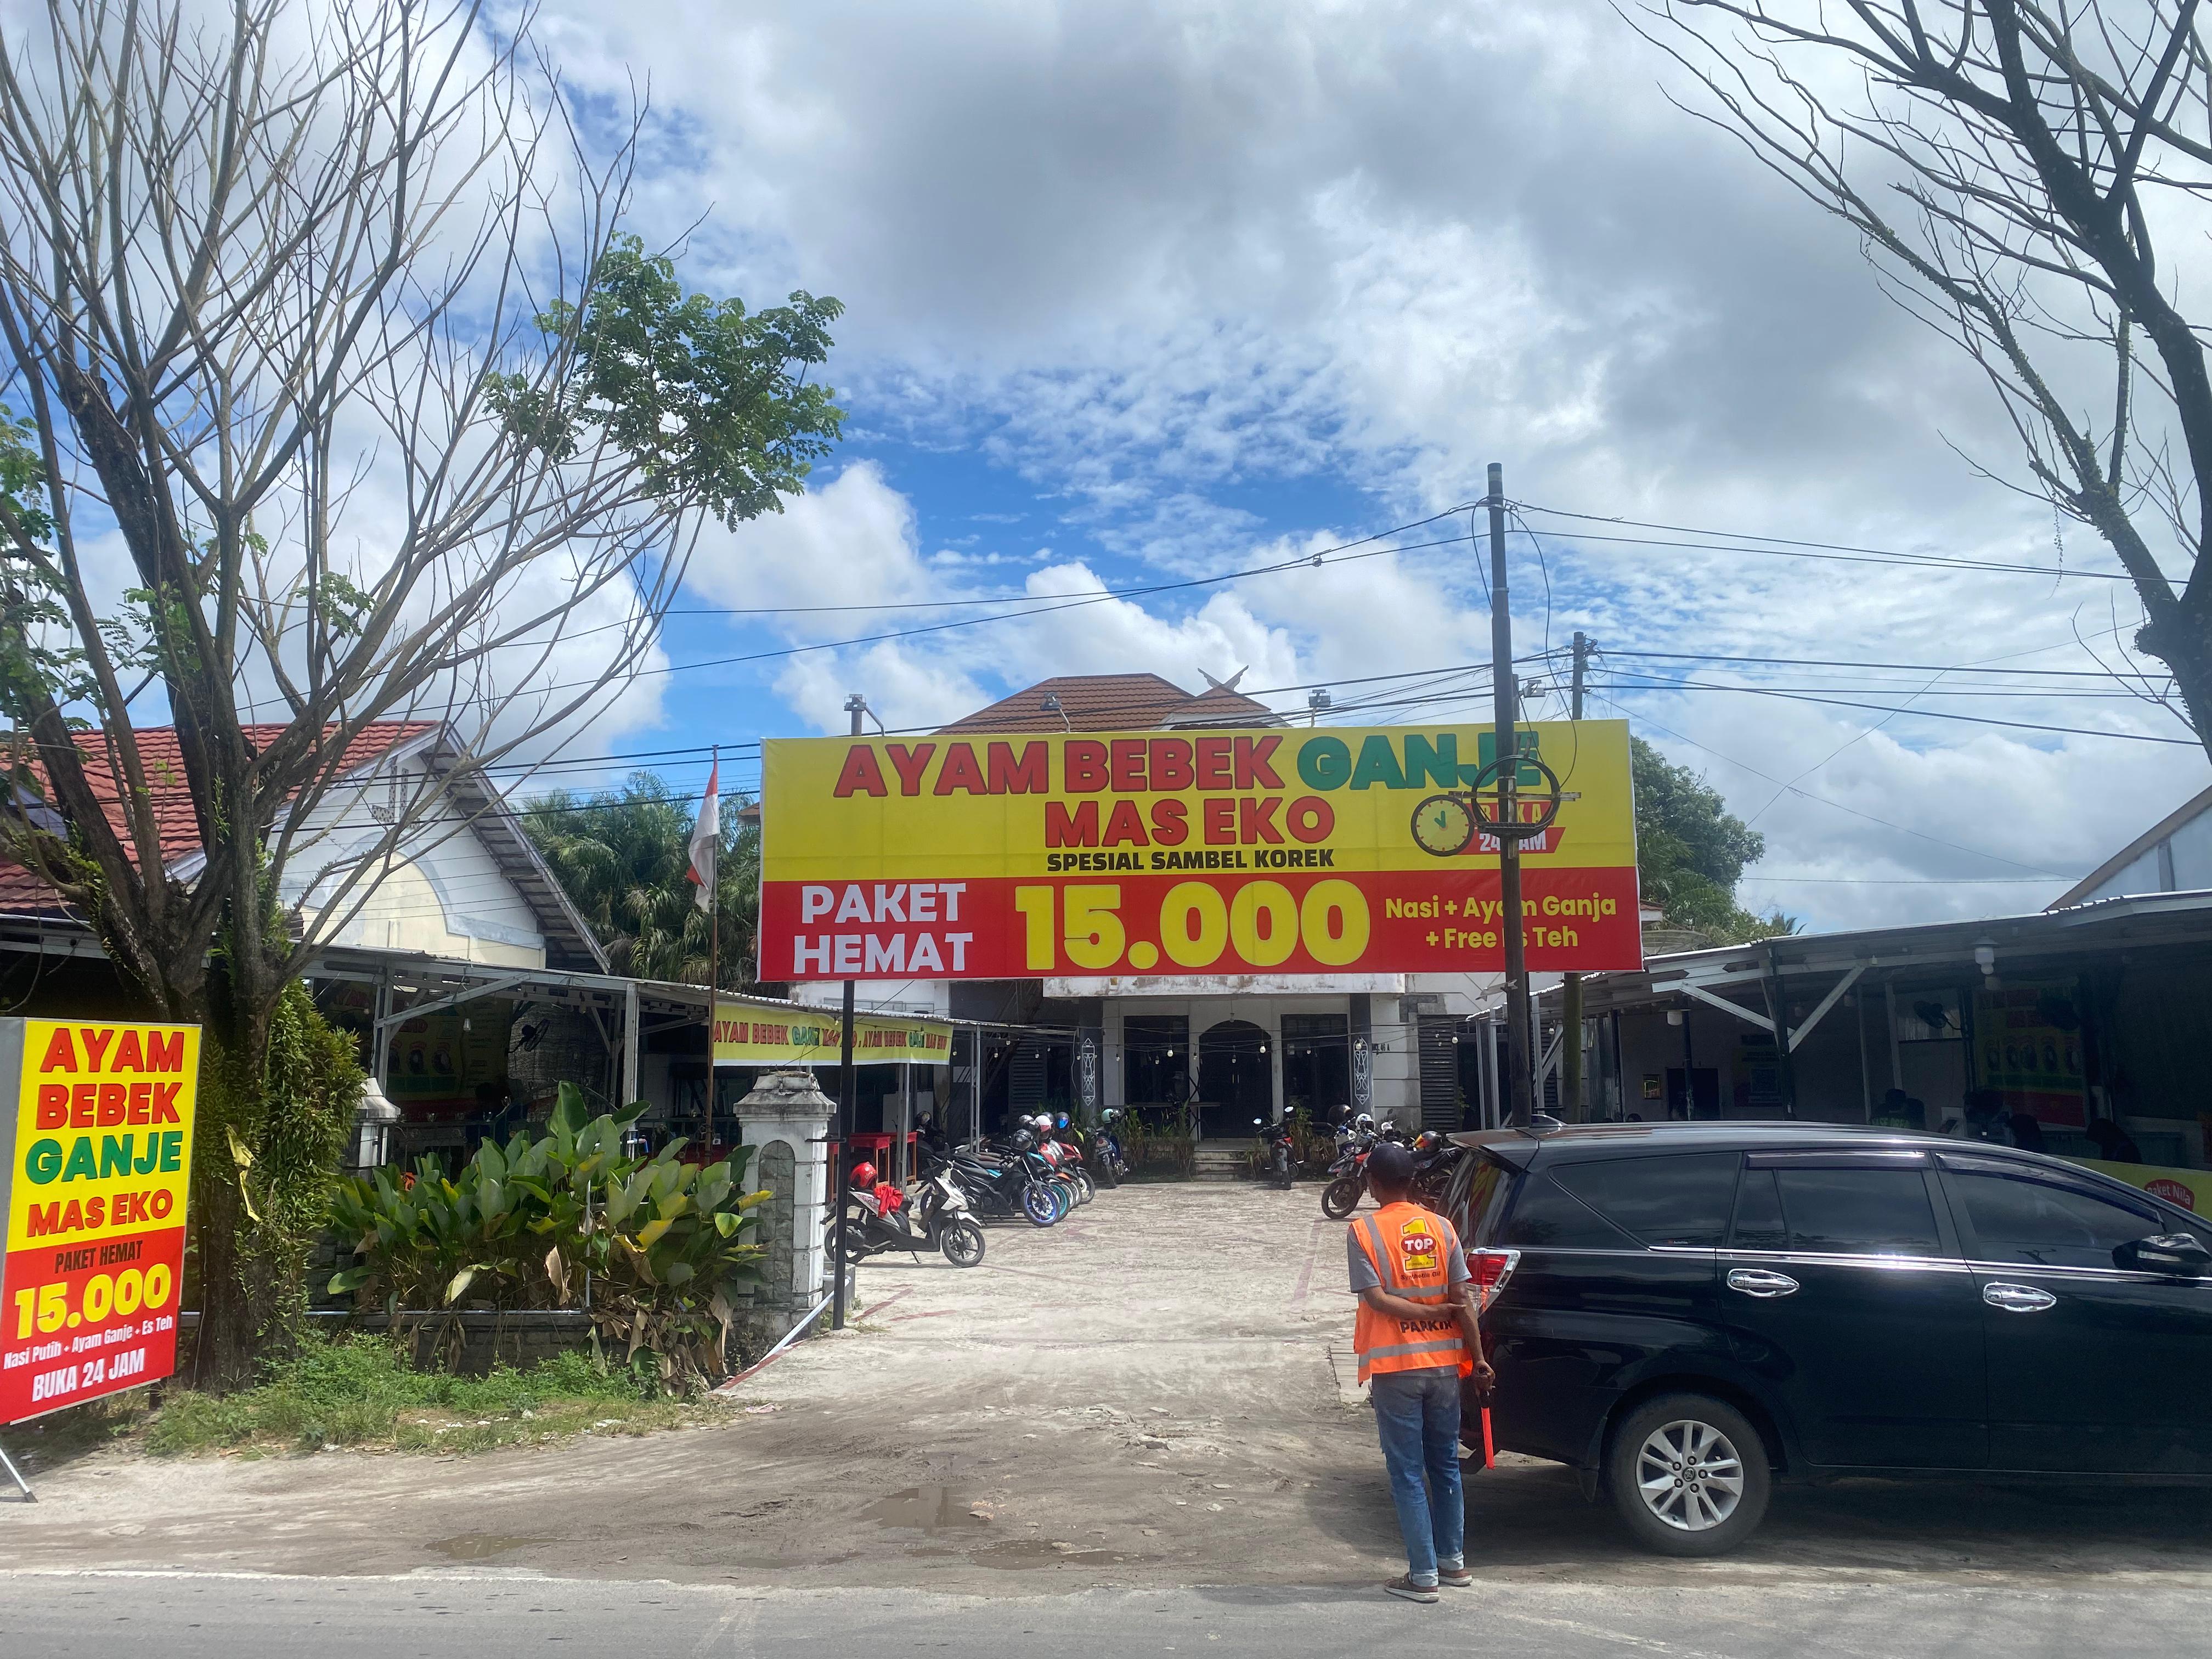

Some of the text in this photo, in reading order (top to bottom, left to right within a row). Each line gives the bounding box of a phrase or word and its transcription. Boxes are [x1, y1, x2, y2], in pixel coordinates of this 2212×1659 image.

[833, 741, 1049, 798] AYAM
[1064, 735, 1286, 794] BEBEK
[1045, 795, 1335, 848] MAS EKO
[1479, 803, 1543, 823] BKA
[1047, 848, 1335, 872] SPESIAL SAMBEL KOREK
[1519, 830, 1547, 850] AM
[802, 882, 966, 924] PAKET
[1015, 879, 1371, 970] 15.000
[1386, 892, 1617, 924] Nasi + Aym Ganja
[793, 932, 973, 974] HEMAT
[1426, 931, 1439, 946] +
[1444, 928, 1497, 949] Free
[1532, 926, 1578, 947] Teh
[40, 1028, 184, 1073] AYAM
[714, 1020, 749, 1043] AYAM
[753, 1023, 789, 1045] BEBEK
[36, 1082, 183, 1130] BEBEK
[25, 1131, 183, 1185] GANJE
[27, 1189, 173, 1238] MAS EKO
[55, 1240, 143, 1274] PAKET HEMAT
[1404, 1238, 1434, 1251] TOP
[15, 1263, 171, 1340] 15.000
[3, 1347, 30, 1369] Nasi
[32, 1340, 61, 1363] Putih
[71, 1333, 101, 1353] Ayam
[104, 1324, 133, 1343] Ganje
[142, 1319, 153, 1335] Es
[156, 1315, 172, 1332] Teh
[32, 1347, 145, 1402] BUKA 24 JAM
